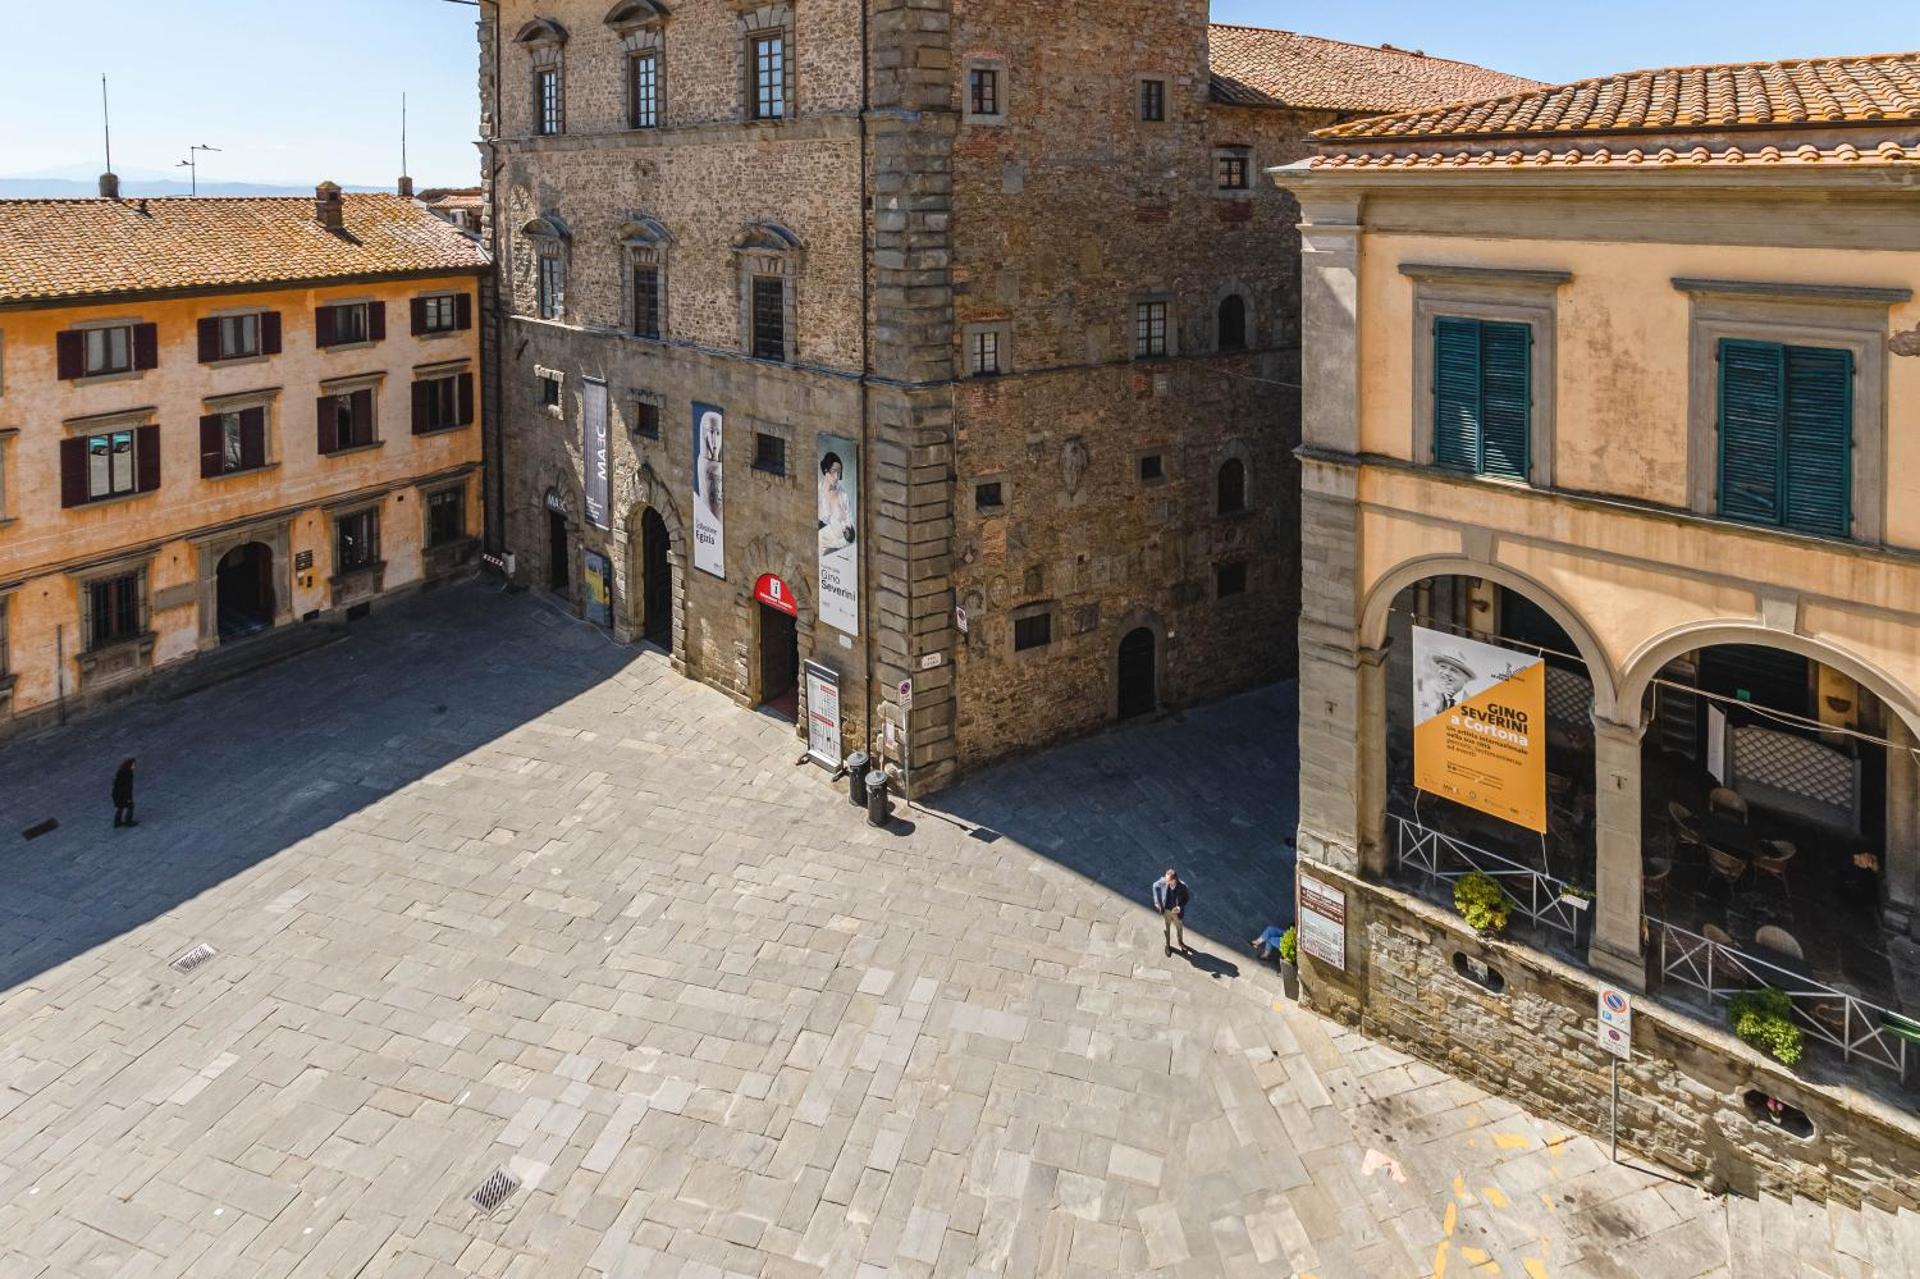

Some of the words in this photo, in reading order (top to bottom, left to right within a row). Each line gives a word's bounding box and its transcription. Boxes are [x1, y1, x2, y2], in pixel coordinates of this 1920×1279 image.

[821, 569, 840, 585] Gino
[821, 579, 856, 602] Severini
[1461, 705, 1528, 736] SEVERINI
[1488, 703, 1528, 723] GINO
[1450, 714, 1460, 725] a
[1464, 716, 1528, 746] Cortona
